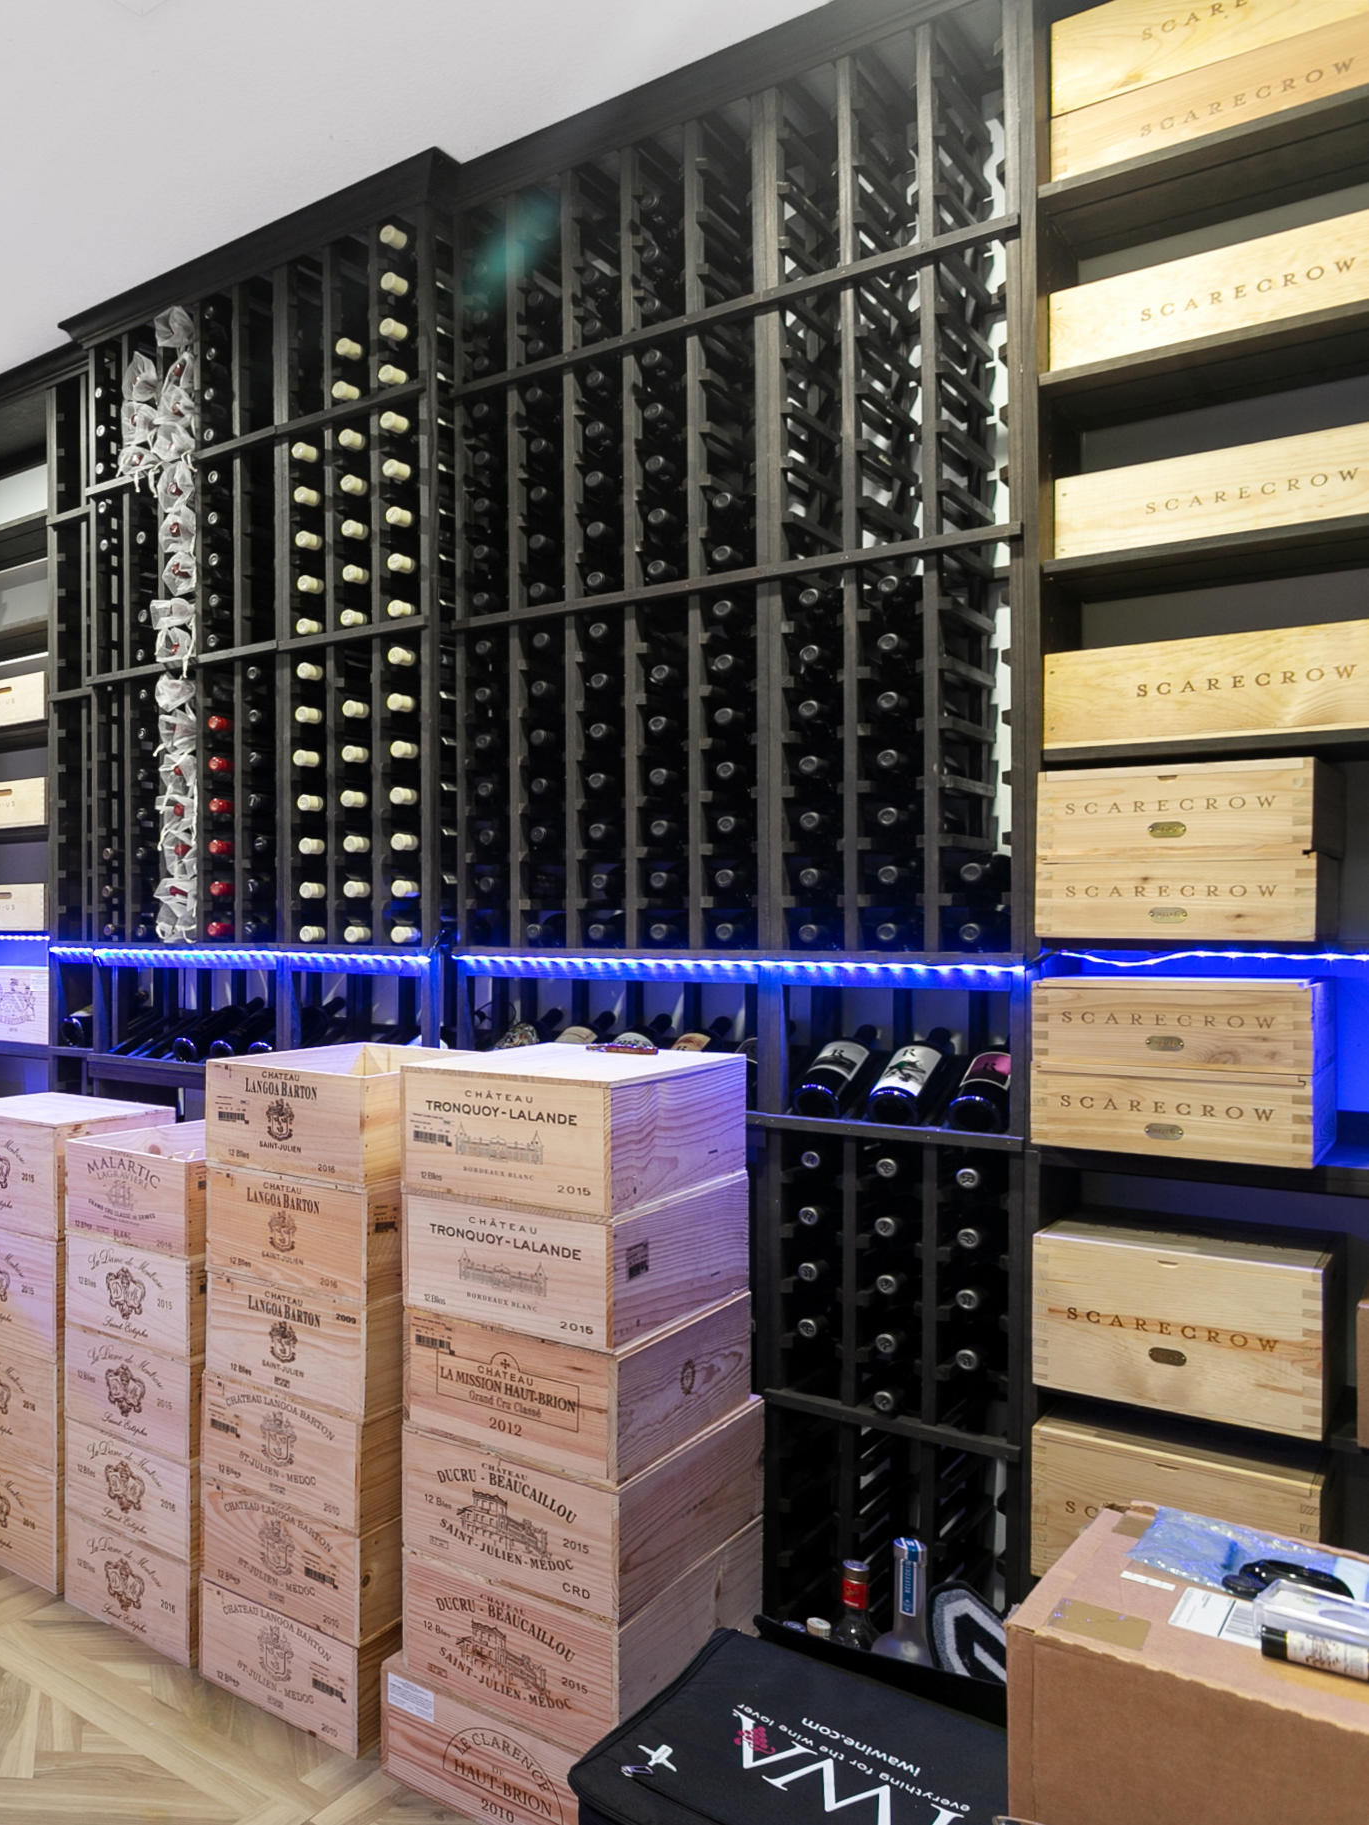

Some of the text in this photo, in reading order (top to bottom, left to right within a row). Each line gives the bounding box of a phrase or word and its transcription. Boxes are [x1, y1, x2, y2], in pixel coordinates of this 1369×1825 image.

[1140, 57, 1355, 138] SCARECROW
[1140, 257, 1356, 322] SCARECROW
[1145, 467, 1359, 514] SCARECROW
[1136, 664, 1358, 697] SCARECROW
[1065, 795, 1277, 815] SCARECROW
[1066, 884, 1278, 898] SCARECROW
[1062, 1010, 1276, 1029] SCARECROW
[261, 1071, 301, 1081] CHATEAU
[245, 1077, 318, 1100] LANGOA BARTON
[465, 1089, 534, 1104] CHÂTEAU
[426, 1100, 578, 1126] TRONQUOY-LALANDE
[1060, 1094, 1276, 1122] SCARECROW
[259, 1141, 302, 1153] SAINT-JULIEN
[87, 1156, 160, 1189] MALARTIC
[463, 1166, 505, 1177] BORDEAUX
[263, 1182, 302, 1194] CHATEAU
[557, 1185, 591, 1197] 2015
[246, 1187, 320, 1215] LANGOA BARTON
[468, 1216, 538, 1235] CHÂTEAU
[429, 1223, 582, 1261] TRONQUOY-LALANDE
[264, 1290, 303, 1308] CHATEAU
[466, 1291, 508, 1306] BORDEAUX
[248, 1295, 321, 1328] LANGOA BARTON
[335, 1313, 357, 1324] 2009
[560, 1321, 594, 1335] 2015
[1066, 1306, 1280, 1353] SCARECROW
[477, 1365, 534, 1387] CHATEAU
[440, 1366, 577, 1414] LA MISSION HAUT-BRION
[226, 1394, 262, 1407] CHATEAU
[300, 1410, 335, 1440] BARTON
[488, 1417, 523, 1437] 2012
[437, 1468, 578, 1524] DUCRU BEAUCAILLOU
[562, 1538, 590, 1554] 2015
[562, 1582, 591, 1600] CRD
[160, 1600, 176, 1614] 2016
[435, 1597, 576, 1663] DUCRU BEAUCAILLOU
[296, 1627, 331, 1663] BARTON
[561, 1677, 588, 1694] 2015
[736, 1703, 972, 1812] everything for the wine lover
[800, 1716, 922, 1778] iwawine.com
[454, 1732, 551, 1793] LE CLARENCE
[453, 1759, 553, 1817] HAUT-BRION
[481, 1799, 515, 1823] 2010
